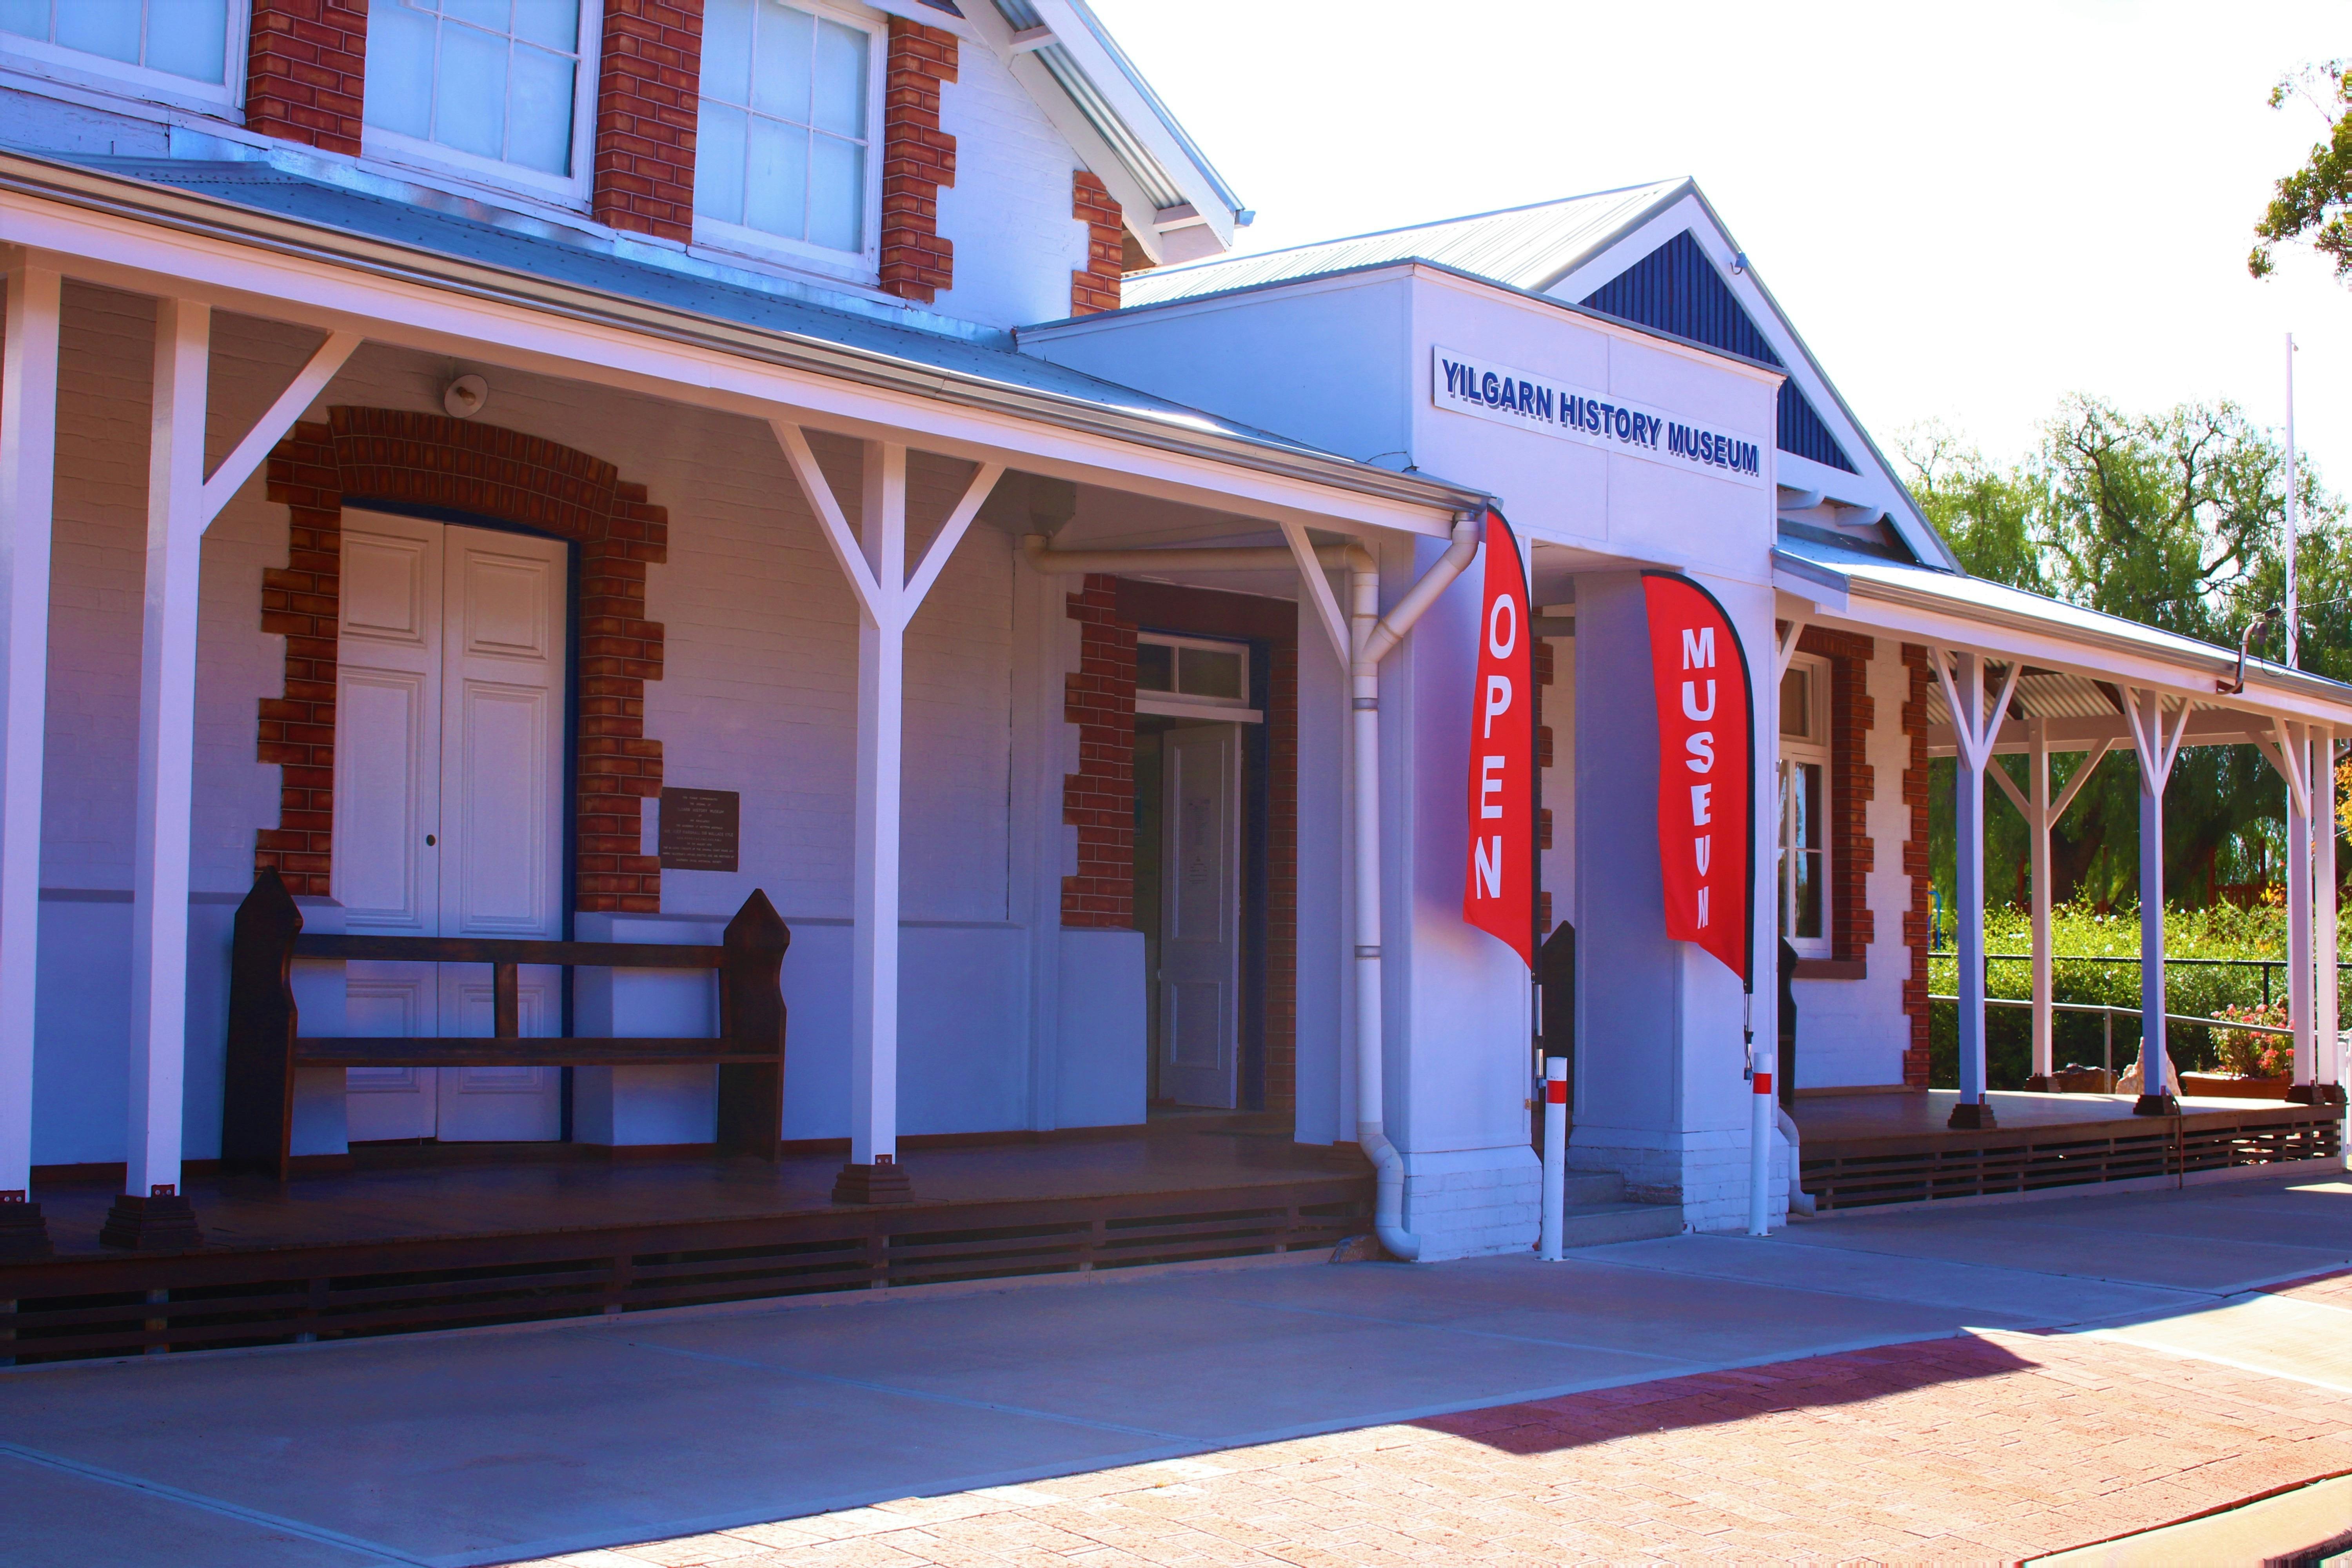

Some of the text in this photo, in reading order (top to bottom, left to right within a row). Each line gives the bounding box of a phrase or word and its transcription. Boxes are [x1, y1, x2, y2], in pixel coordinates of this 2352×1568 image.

[1442, 358, 1760, 477] YILGARN HISTORY MUSEUM
[1474, 594, 1516, 900] OPEN
[1682, 627, 1716, 930] MUSEUM
